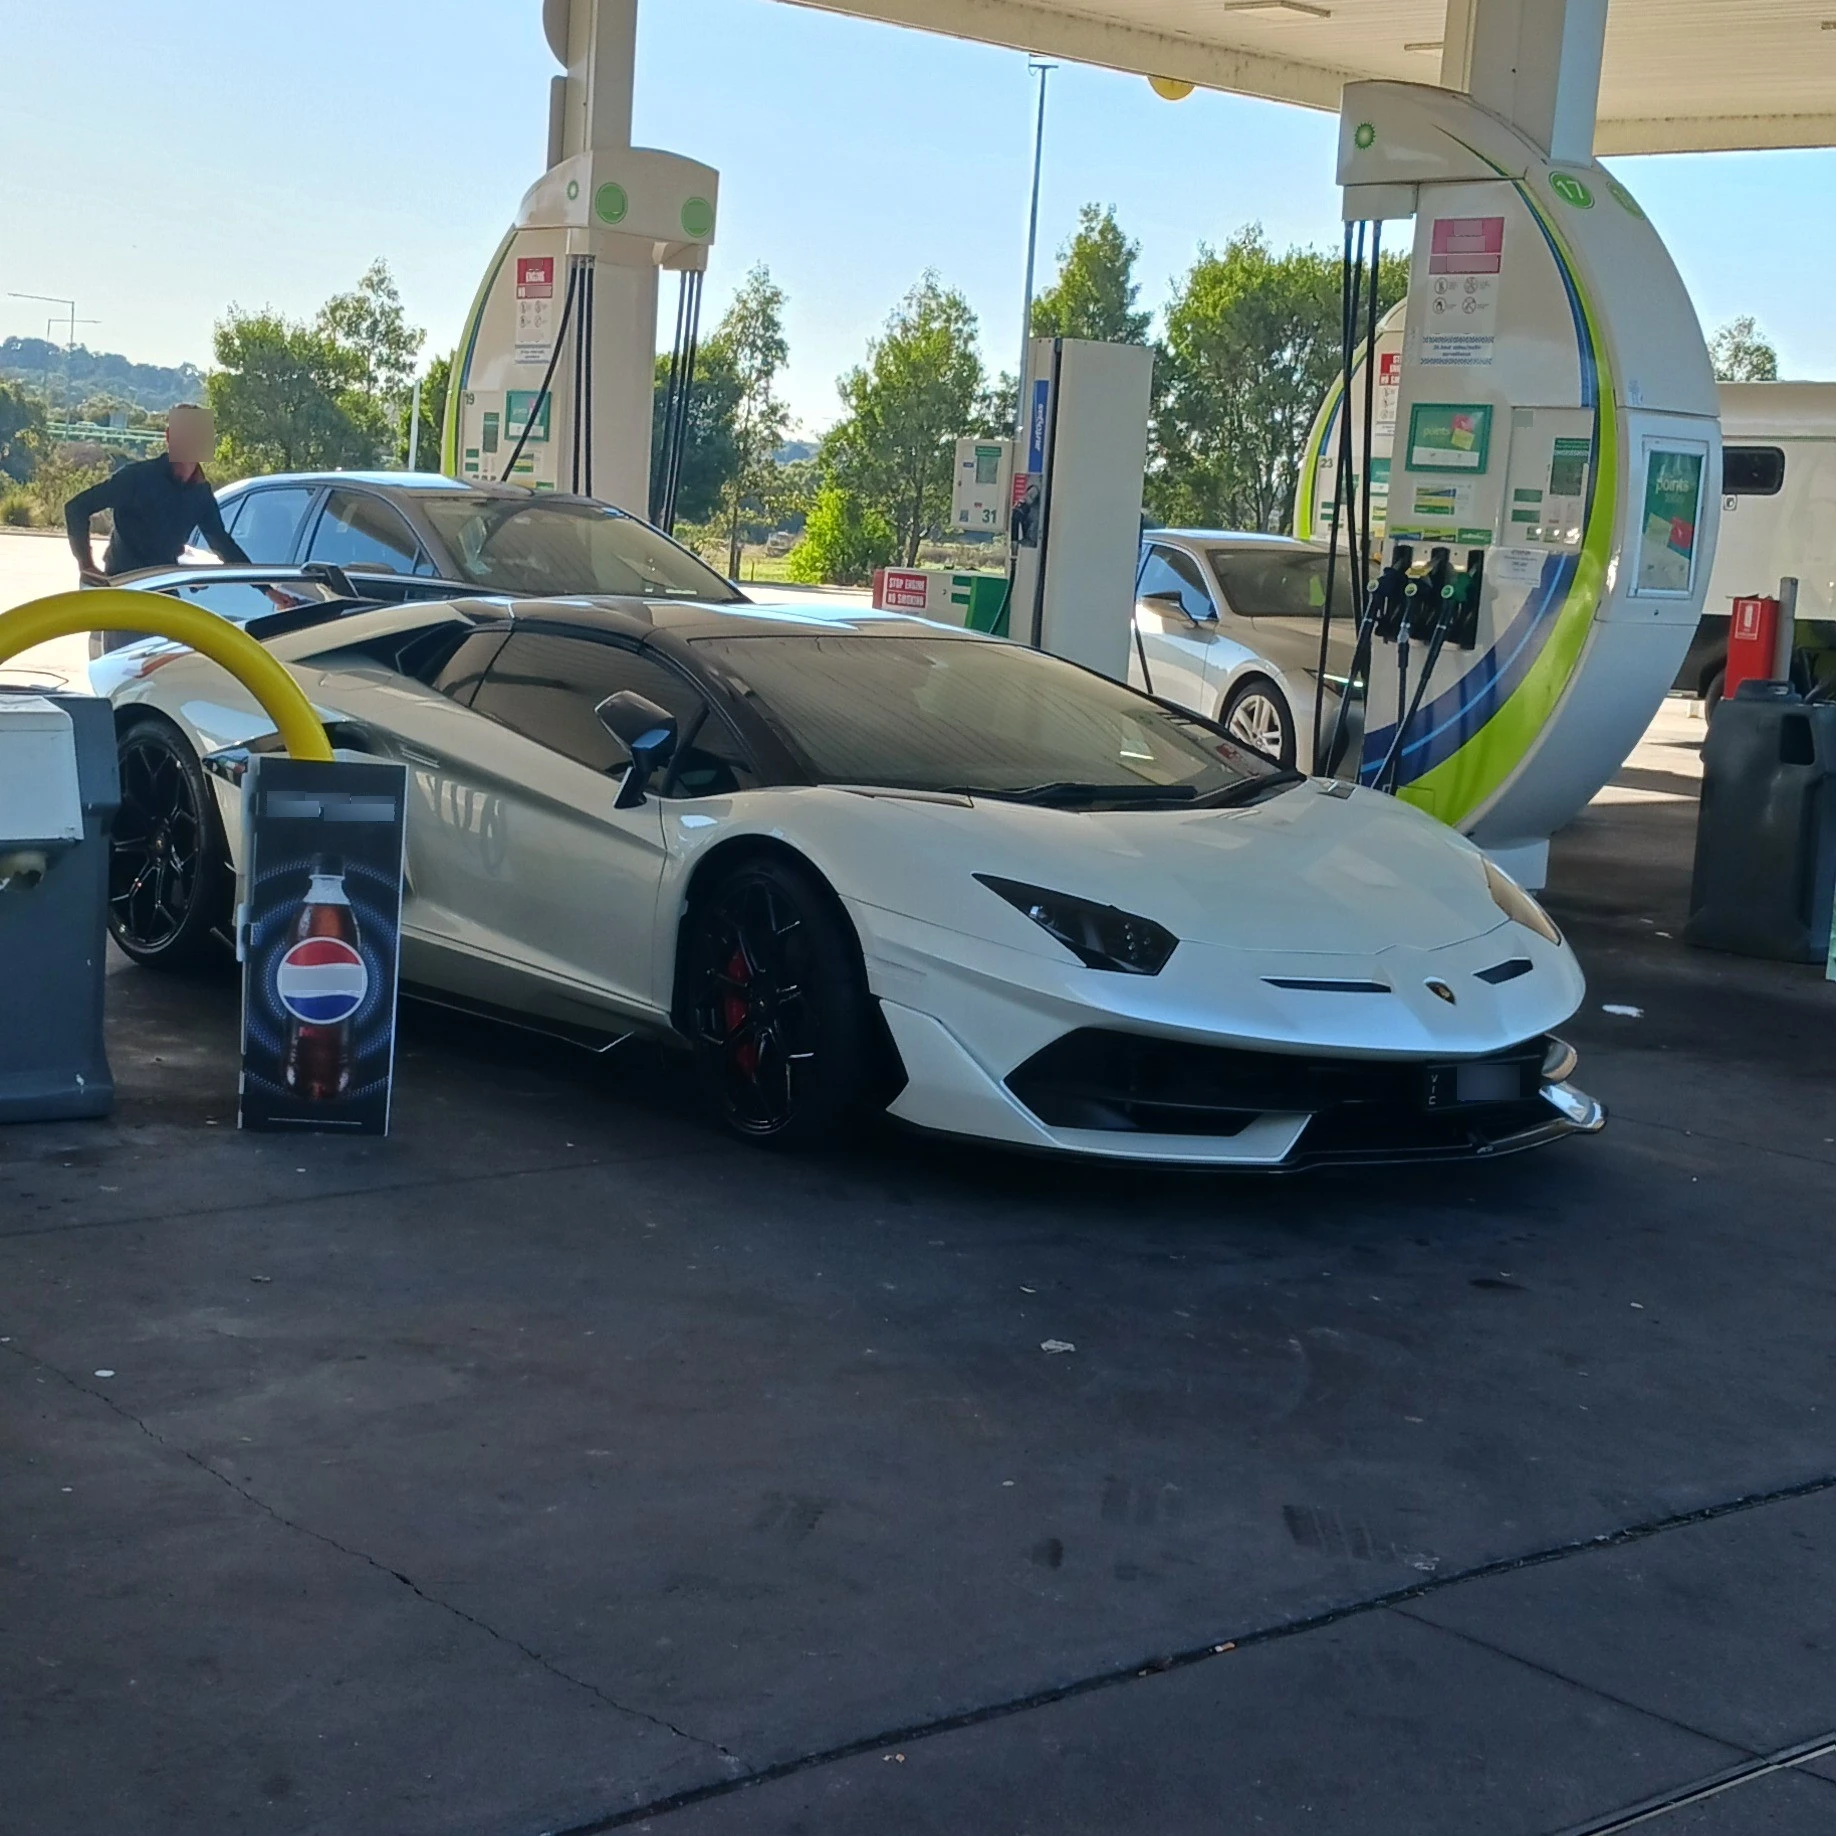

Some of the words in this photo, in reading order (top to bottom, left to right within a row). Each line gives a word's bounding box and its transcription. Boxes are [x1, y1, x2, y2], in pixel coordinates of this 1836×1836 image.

[1556, 180, 1584, 200] 17
[1320, 458, 1333, 469] 23
[1654, 476, 1690, 495] points
[982, 508, 997, 524] 31
[888, 577, 904, 589] STOP
[887, 592, 897, 604] NO
[1428, 1074, 1439, 1106] VIC
